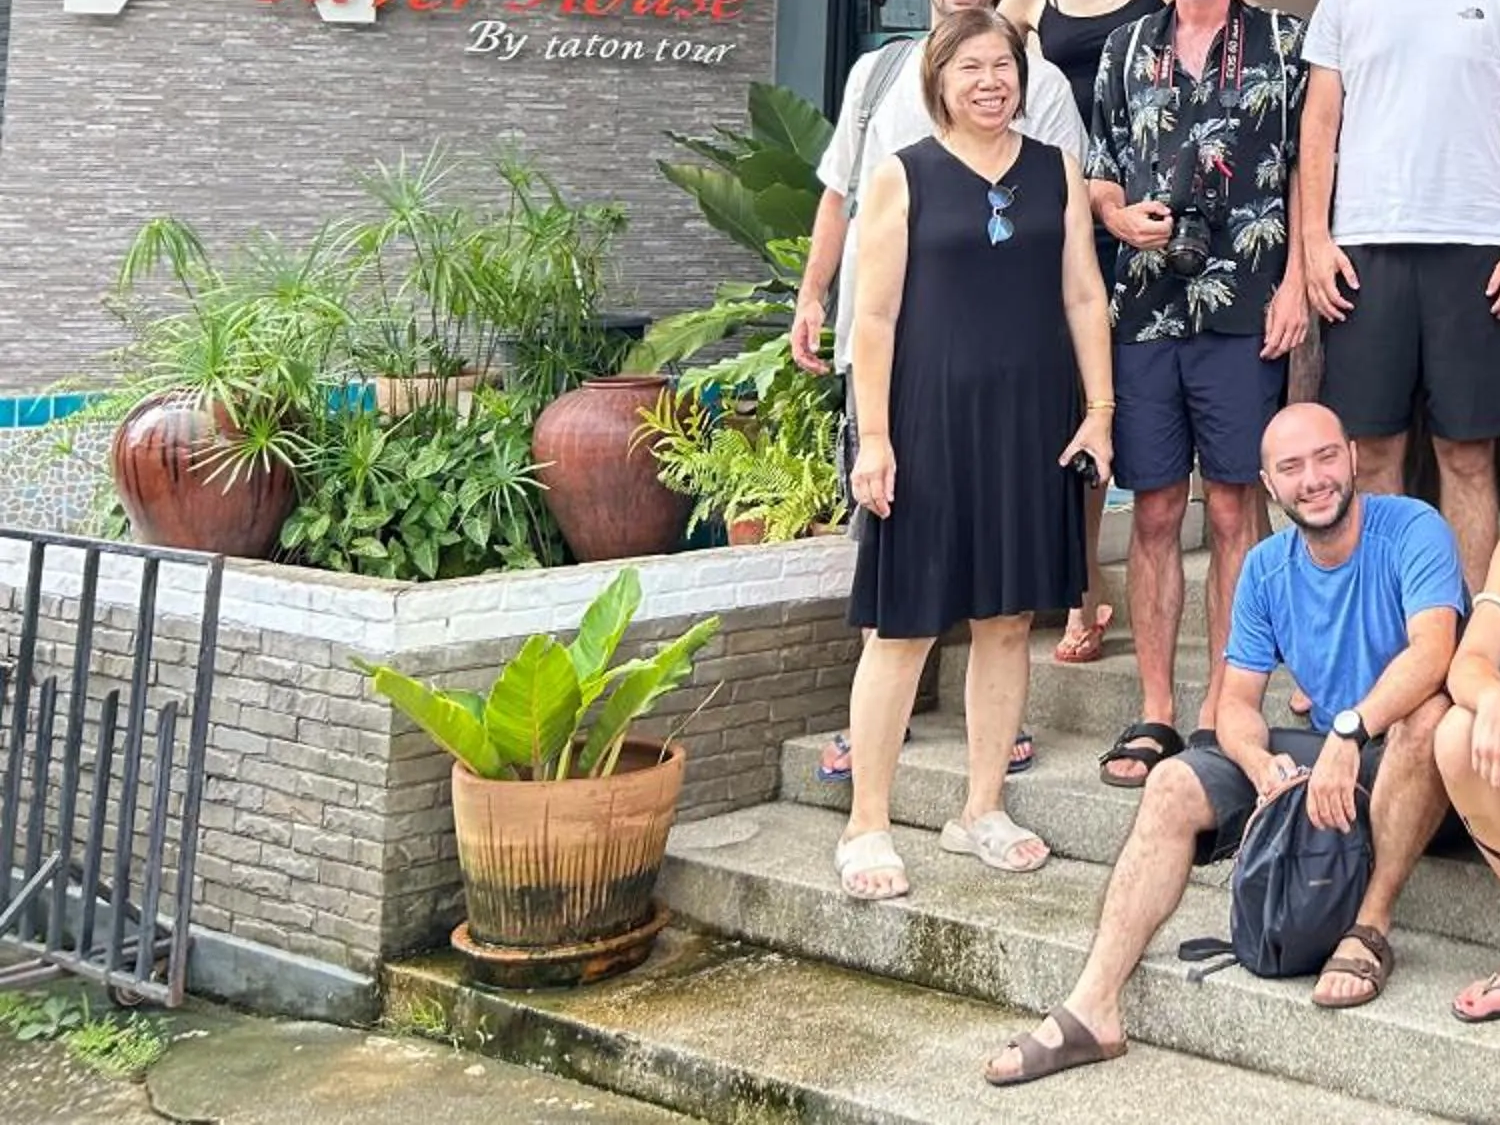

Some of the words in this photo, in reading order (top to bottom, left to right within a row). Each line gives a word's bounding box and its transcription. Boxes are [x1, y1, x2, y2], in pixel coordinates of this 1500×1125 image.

[465, 20, 529, 62] By
[542, 31, 646, 62] taton
[654, 35, 737, 67] tour
